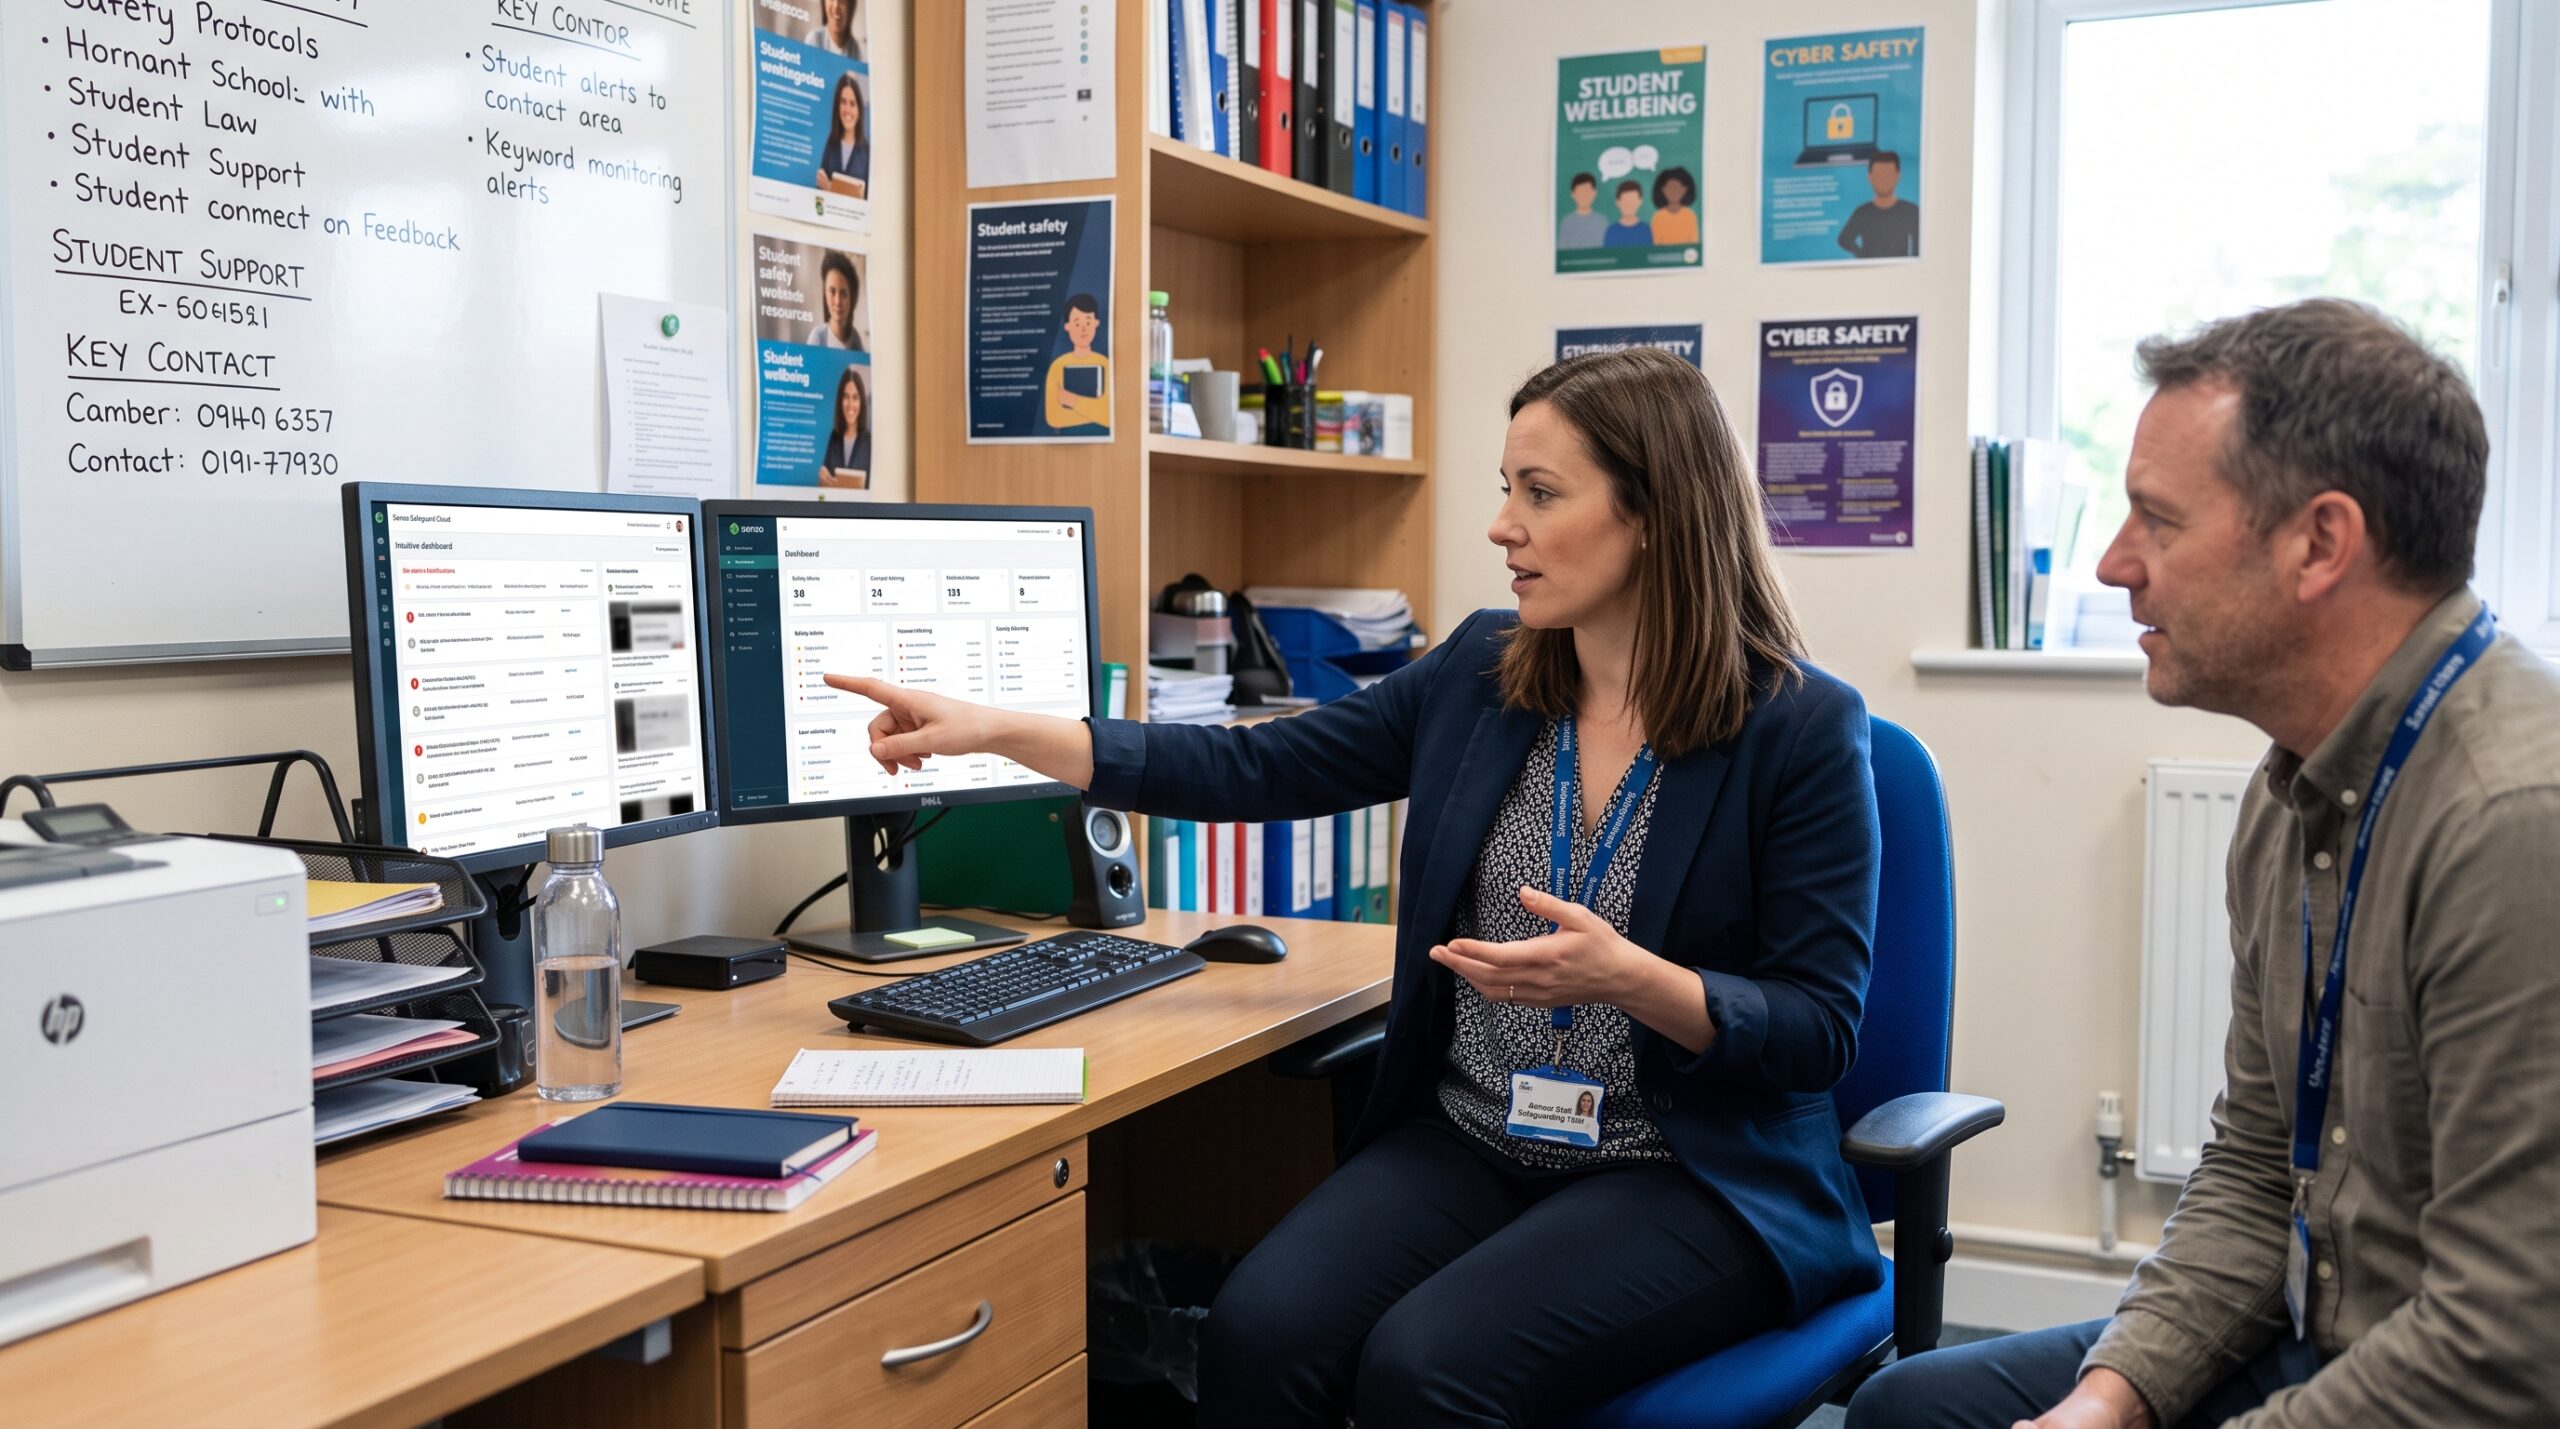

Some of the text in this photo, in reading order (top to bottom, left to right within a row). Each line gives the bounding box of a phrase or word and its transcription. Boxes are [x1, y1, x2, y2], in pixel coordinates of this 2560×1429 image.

[196, 1, 320, 60] Protocols
[497, 0, 539, 27] KEY
[551, 6, 633, 50] CONTOR
[1770, 38, 1919, 67] CYBER SAFETY
[66, 26, 193, 82] Hornant
[320, 86, 375, 119] with
[481, 44, 667, 111] Student alerts to
[1578, 69, 1684, 100] STUDENT
[68, 77, 259, 137] Student Law
[485, 90, 624, 136] contact area
[1563, 92, 1698, 123] WELLBEING
[72, 123, 308, 193] Student Support
[485, 127, 684, 206] Keyword monitoring
[486, 171, 550, 206] alerts
[75, 173, 191, 216] Student
[323, 217, 352, 237] on
[364, 212, 462, 253] Feedback
[977, 218, 1069, 238] Student safety
[53, 228, 307, 290] STUDENT SUPPORT
[759, 245, 802, 267] Student
[760, 266, 794, 287] safety
[761, 305, 814, 323] resources
[1765, 324, 1911, 347] CYBER SAFETY
[67, 333, 278, 380] KEY CONTACT
[764, 349, 804, 368] Student
[66, 391, 182, 427] Camber:
[68, 442, 340, 478] Contact: 0191-77930
[871, 588, 883, 598] 24
[41, 993, 85, 1045] hp
